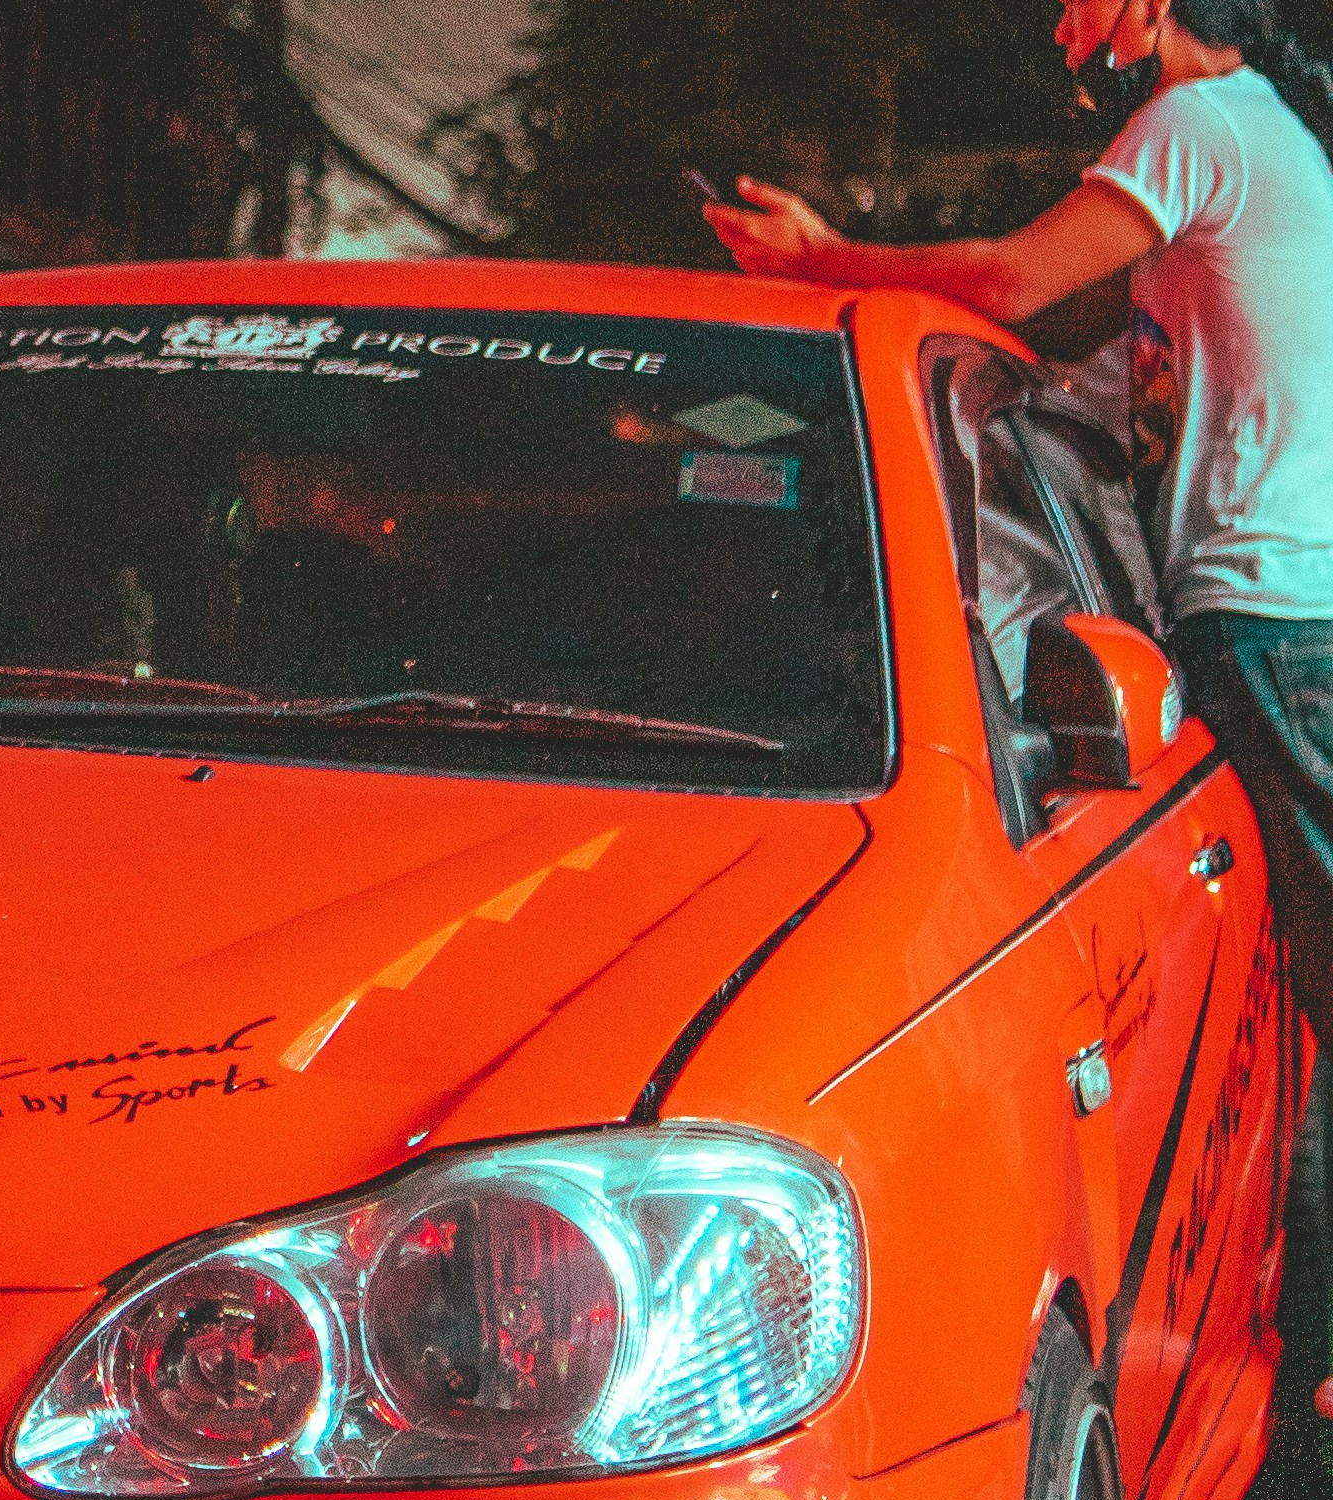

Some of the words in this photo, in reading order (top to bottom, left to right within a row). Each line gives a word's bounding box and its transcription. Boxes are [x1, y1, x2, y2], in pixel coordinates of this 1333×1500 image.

[350, 331, 667, 375] PRODUCE
[20, 1091, 69, 1116] by
[88, 1063, 277, 1125] Sports
